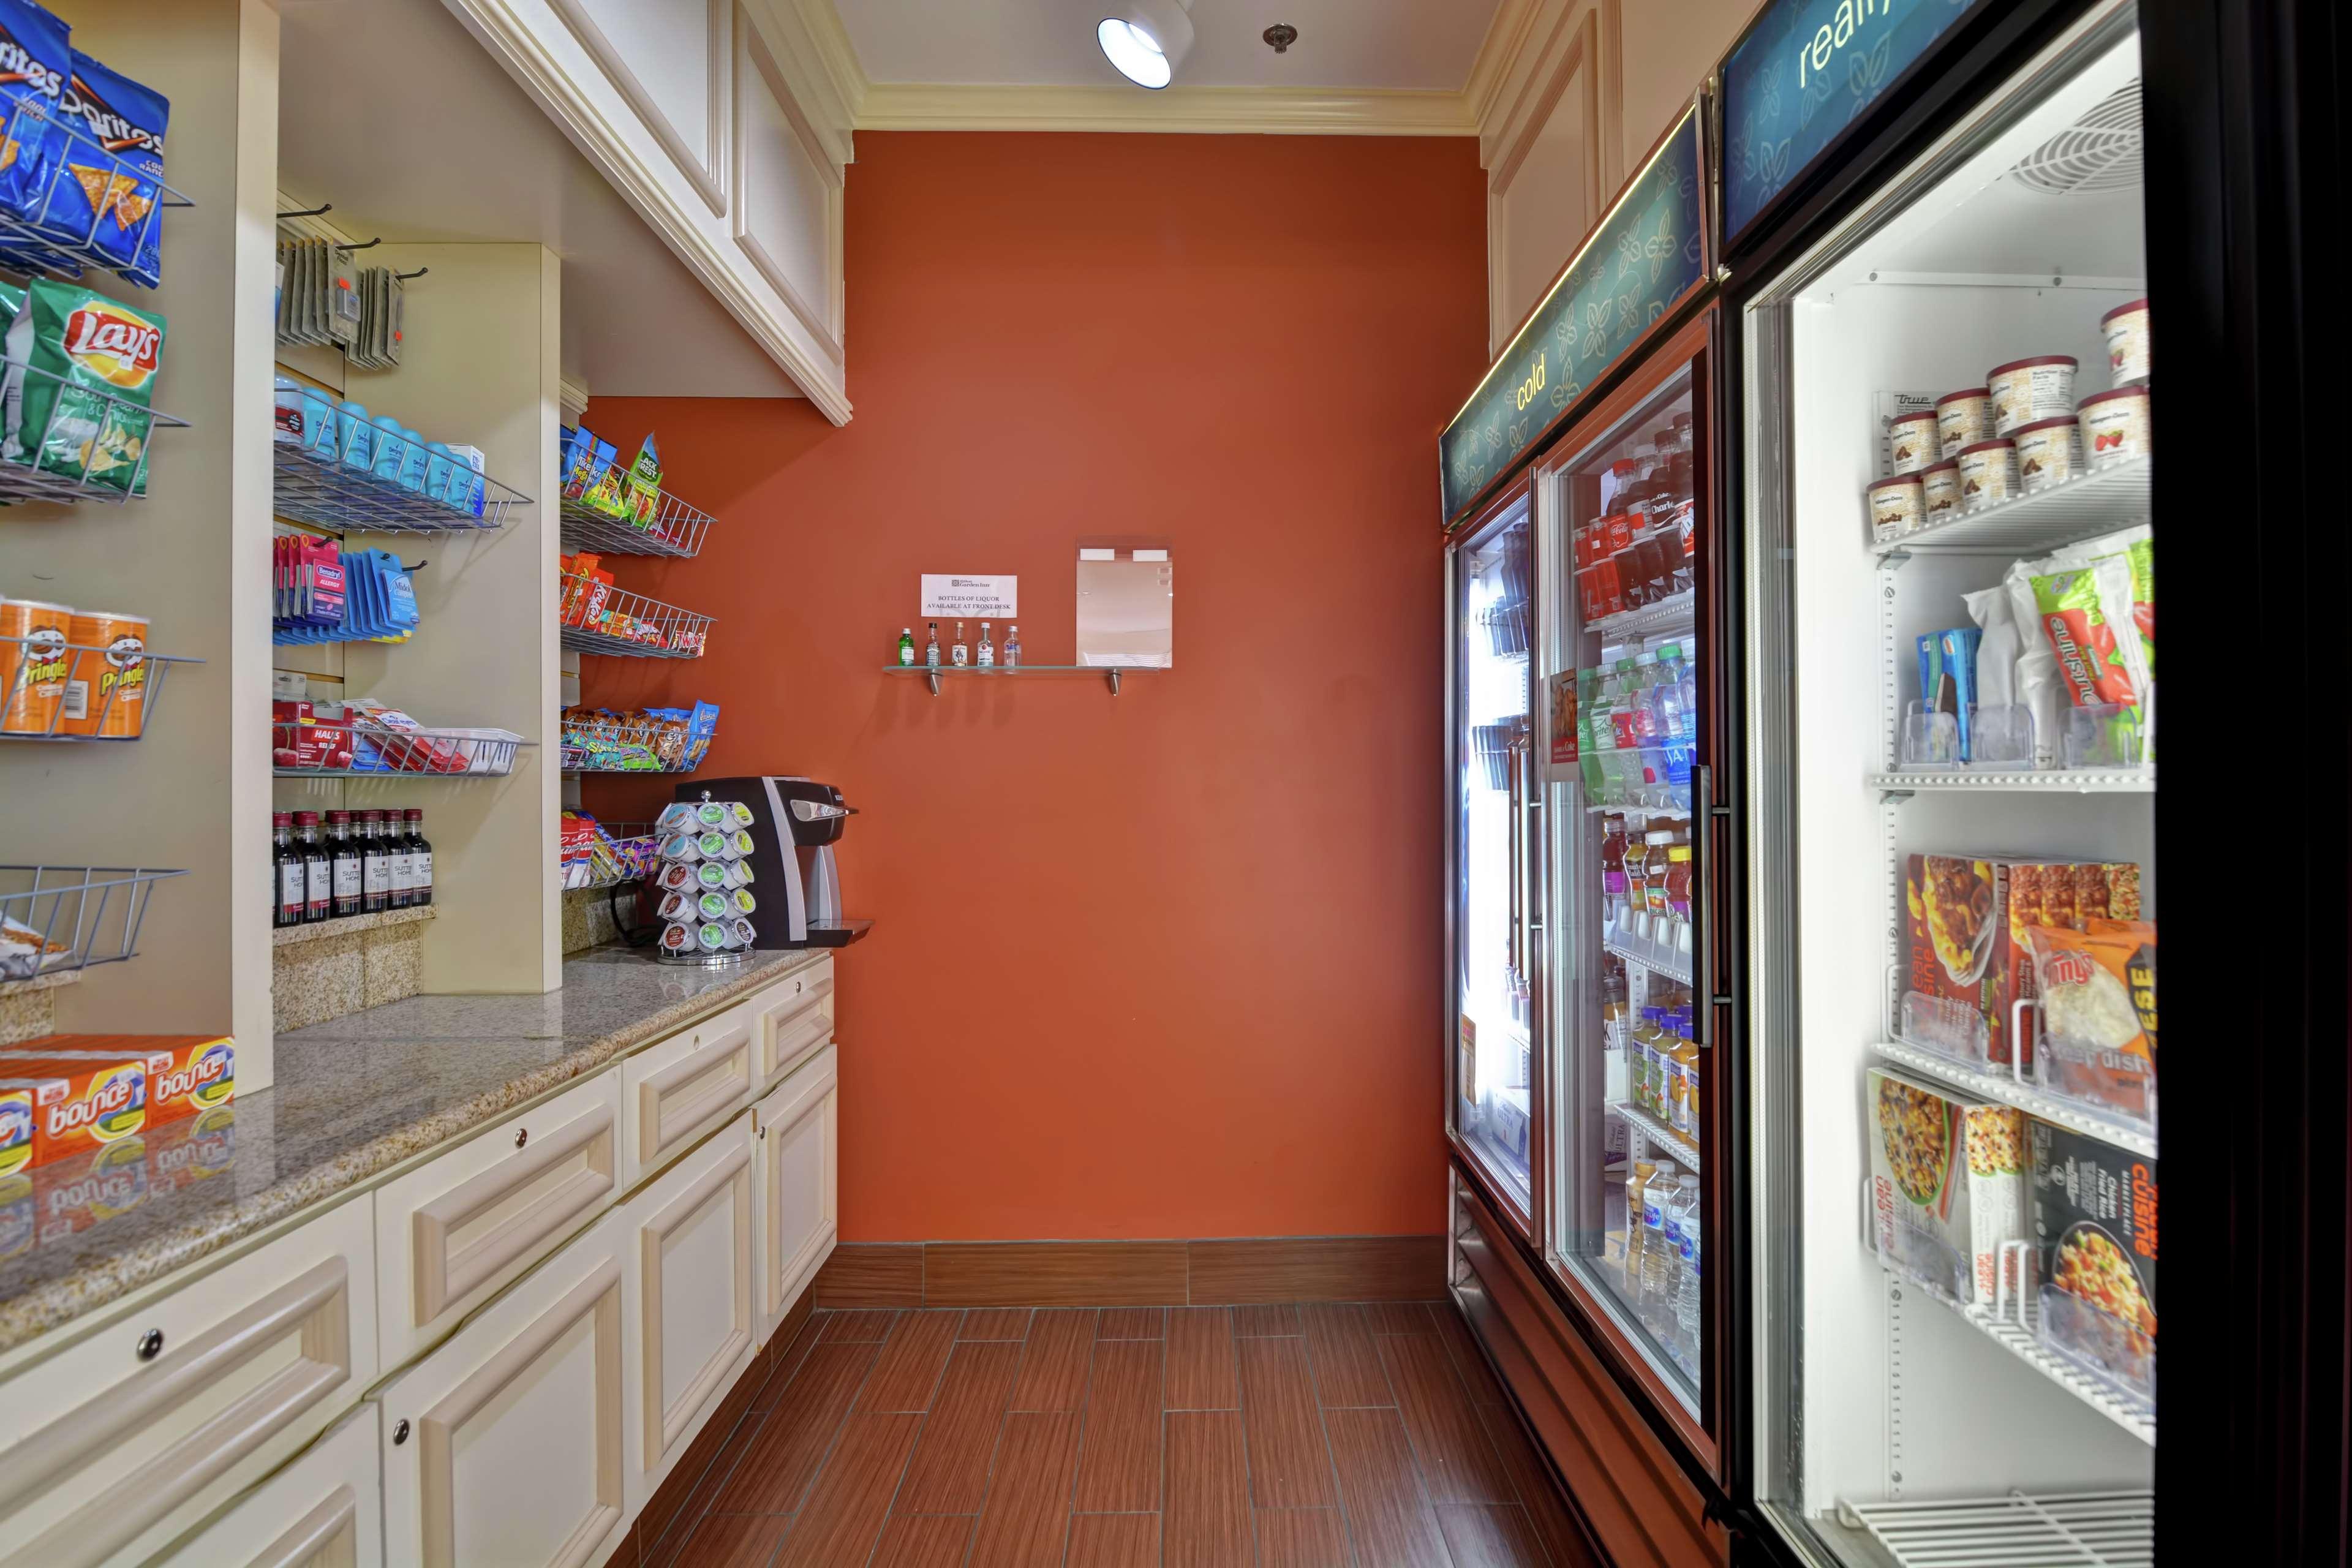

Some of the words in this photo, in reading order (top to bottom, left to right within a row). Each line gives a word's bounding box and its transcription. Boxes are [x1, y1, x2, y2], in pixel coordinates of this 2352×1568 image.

[0, 40, 62, 97] ritos
[59, 88, 164, 156] Doritos
[139, 163, 164, 178] RANC
[71, 312, 159, 371] Lay's
[1517, 353, 1547, 411] cold
[1894, 394, 1931, 404] true
[639, 463, 657, 478] REST
[641, 458, 657, 470] ACK
[318, 567, 342, 580] Benadryl
[320, 579, 340, 588] ALLERGY
[2050, 617, 2102, 705] Outshine
[314, 729, 341, 741] HALS
[49, 1082, 130, 1136] bounce
[1615, 1125, 1626, 1153] ULTRA
[2097, 1167, 2108, 1195] Fried
[2098, 1195, 2108, 1220] Rice
[2107, 1176, 2118, 1219] Chicken
[2131, 1162, 2151, 1257] cuisine
